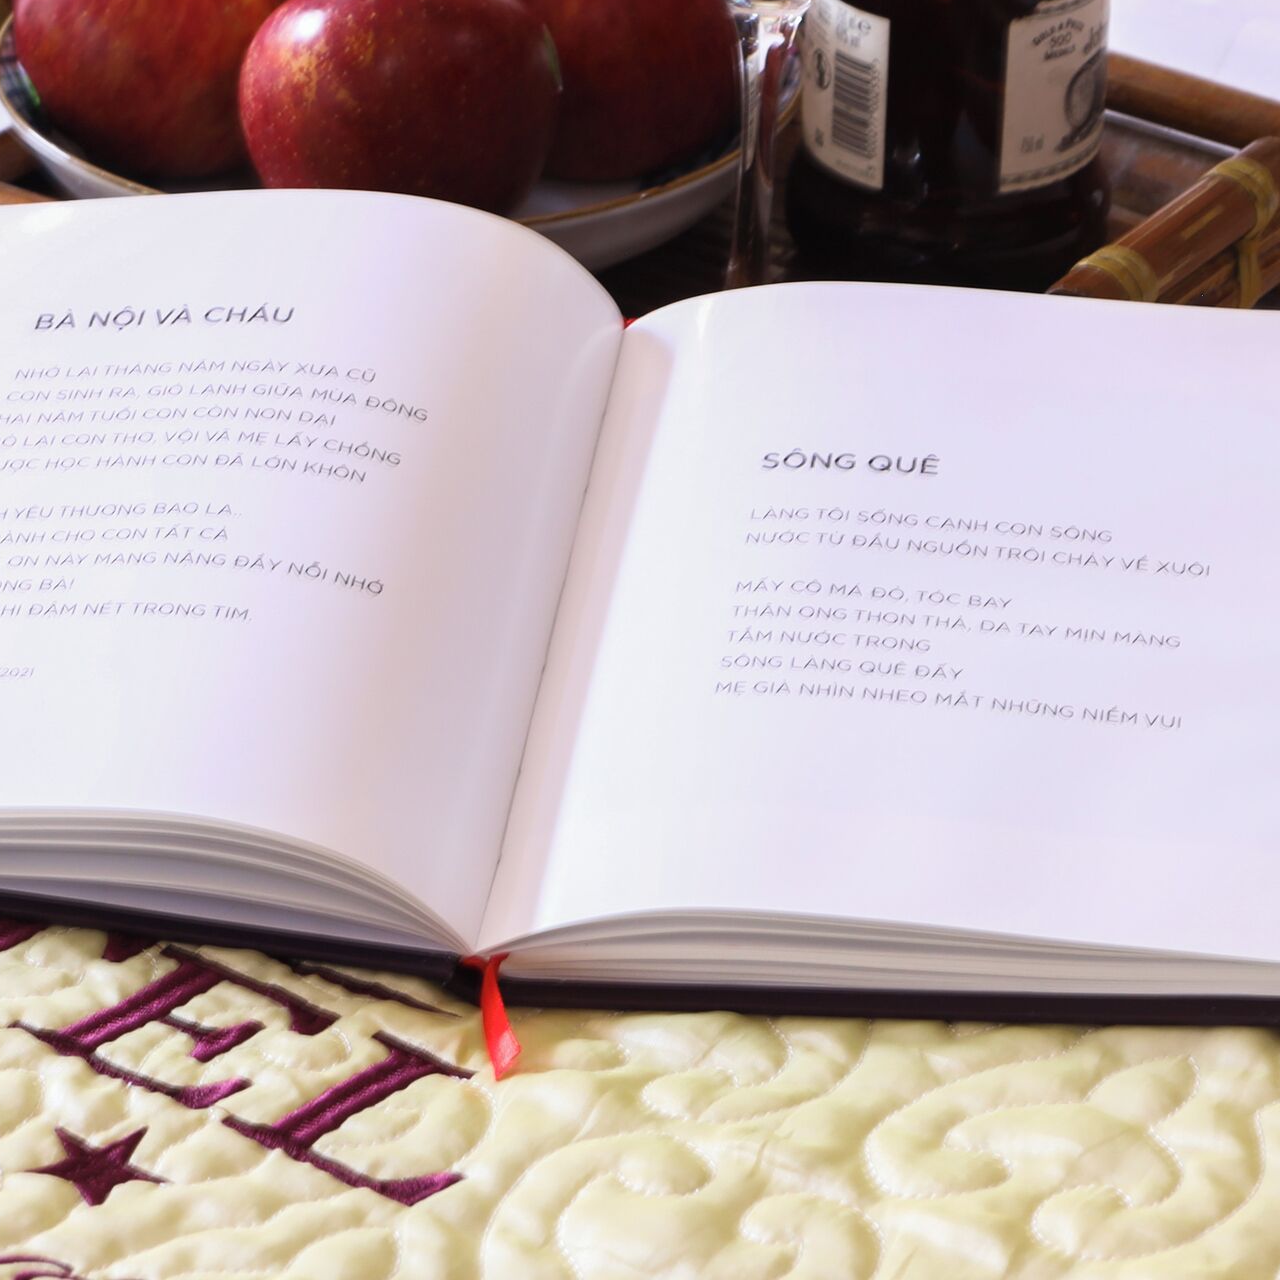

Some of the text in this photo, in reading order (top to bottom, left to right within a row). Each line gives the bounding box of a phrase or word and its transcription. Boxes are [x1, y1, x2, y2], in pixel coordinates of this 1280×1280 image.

[34, 303, 294, 331] BÀ NỘI VÀ CHÁU
[6, 390, 51, 402] CON
[56, 388, 103, 401] SINH
[141, 408, 187, 420] CON
[244, 407, 292, 422] NON
[61, 434, 107, 446] CON
[162, 454, 208, 466] CON
[762, 448, 939, 475] SÔNG QUÊ
[152, 502, 199, 515] BAO
[50, 529, 96, 543] CHO
[101, 528, 148, 540] CON
[994, 521, 1043, 537] CON
[94, 552, 156, 565] MANG
[133, 602, 206, 617] TRONG
[967, 595, 1012, 609] BAY
[798, 606, 847, 621] ONG
[856, 609, 916, 626] THON
[980, 620, 1010, 633] DA
[1020, 623, 1058, 637] TAY
[855, 634, 930, 653] TRONG
[1145, 714, 1181, 729] VUI
